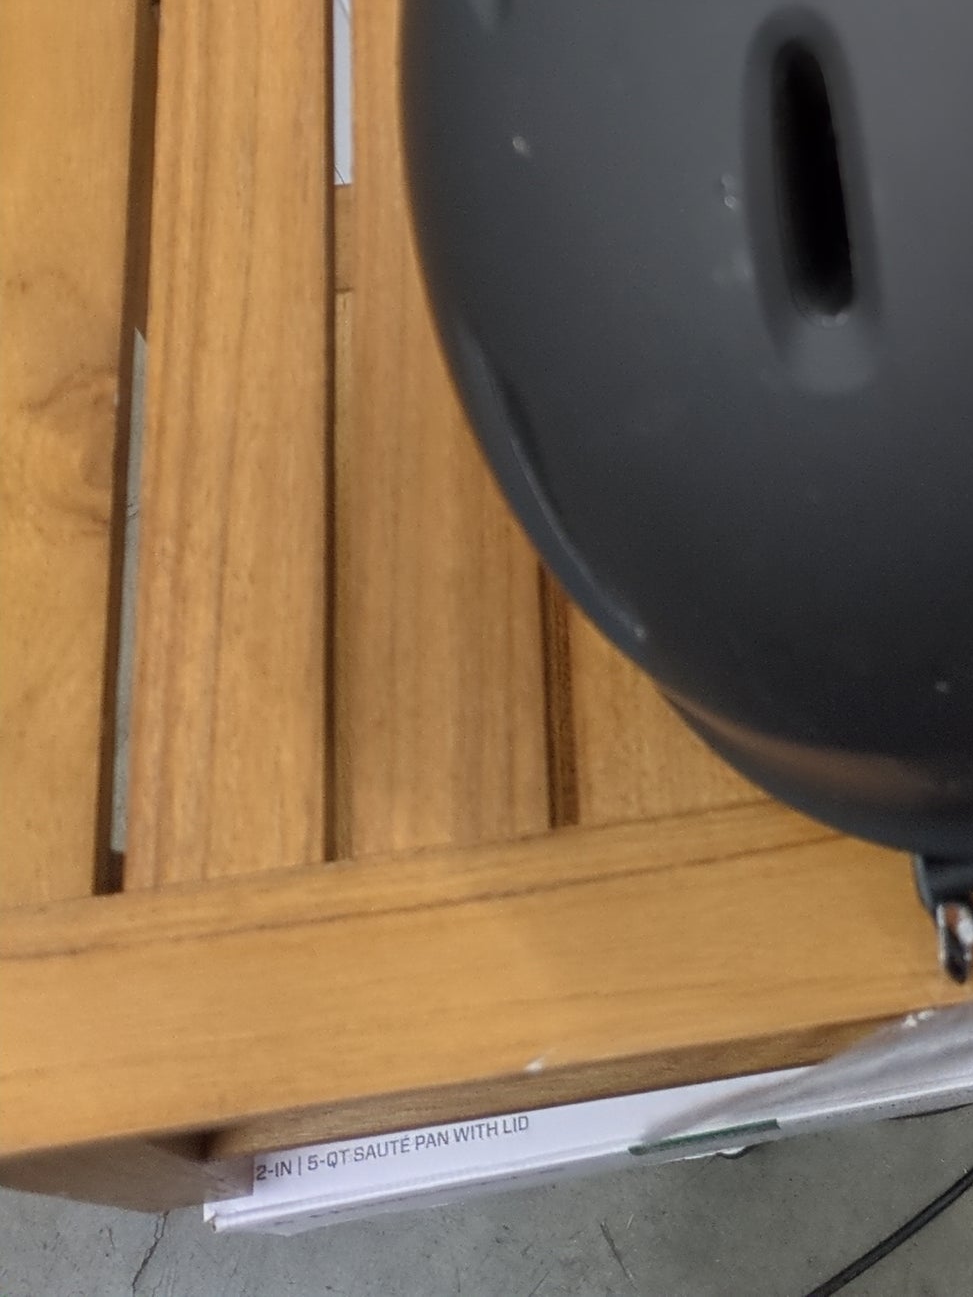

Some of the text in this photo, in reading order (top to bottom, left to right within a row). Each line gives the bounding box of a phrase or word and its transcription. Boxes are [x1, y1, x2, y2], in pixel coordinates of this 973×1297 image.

[307, 1149, 350, 1172] 5-QT
[354, 1135, 410, 1163] SAUTÉ
[415, 1130, 449, 1151] PAN
[453, 1122, 499, 1144] WITH
[502, 1115, 529, 1134] LID
